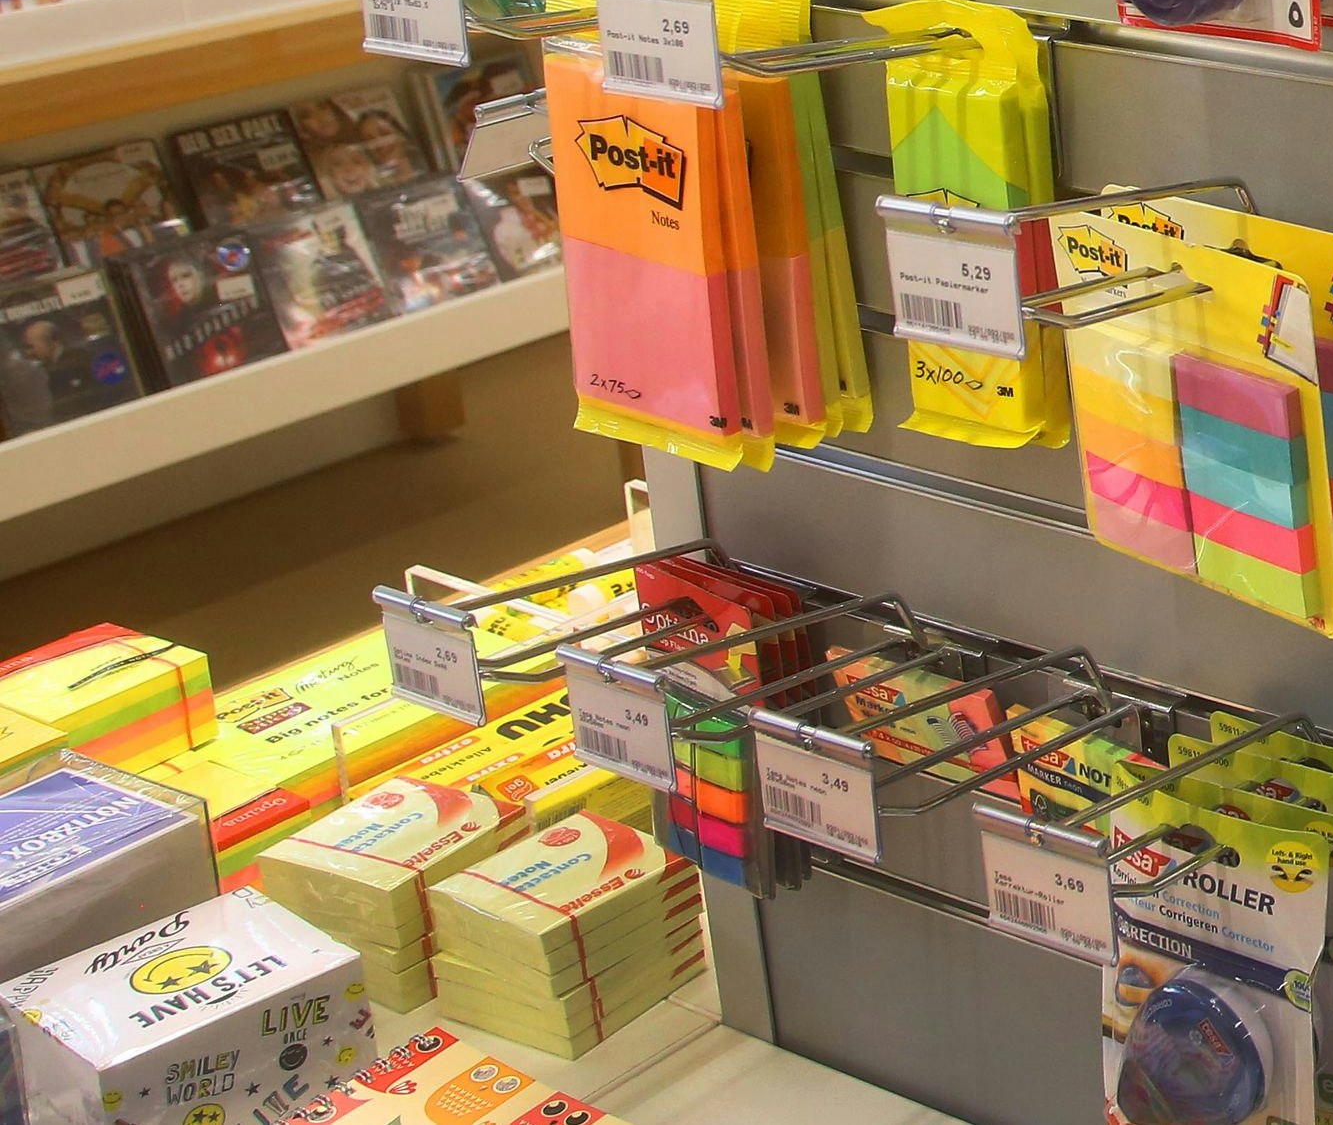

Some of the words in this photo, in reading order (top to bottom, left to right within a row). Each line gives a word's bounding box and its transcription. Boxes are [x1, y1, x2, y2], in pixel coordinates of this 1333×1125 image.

[606, 29, 635, 42] Post-it
[638, 35, 660, 45] Notes
[662, 18, 690, 35] 2,69
[588, 132, 679, 179] Post-it
[650, 209, 681, 232] Notes
[1067, 235, 1124, 270] Post-it
[900, 271, 932, 285] Post-it
[961, 263, 991, 282] 5,29
[590, 373, 627, 396] 2x75
[915, 360, 965, 386] 3x100
[996, 385, 1015, 399] 3M
[709, 415, 728, 429] 3M
[783, 401, 801, 416] 3M
[435, 647, 457, 664] 2,69
[266, 727, 302, 744] Big
[306, 700, 359, 728] notes
[361, 687, 390, 703] for
[624, 709, 649, 726] 3,49
[420, 737, 474, 765] extra
[466, 753, 520, 782] extra
[1027, 762, 1063, 787] MARKER
[822, 772, 849, 793] 3,49
[220, 797, 288, 828] Optima
[1, 796, 145, 863] NOTIZBOX
[401, 830, 465, 870] Esselte
[1271, 848, 1287, 860] Left-
[1295, 850, 1314, 862] Right
[1276, 855, 1292, 866] hand
[1293, 858, 1307, 867] use
[497, 860, 552, 888] Notes
[1055, 873, 1084, 893] 3,69
[559, 876, 626, 914] Esselte
[1162, 890, 1220, 920] Correction
[1182, 870, 1277, 917] ROLLER
[84, 909, 192, 975] Party
[1159, 904, 1219, 935] Corrigeren
[1221, 926, 1276, 954] Corrector
[212, 955, 288, 994] LET'S
[128, 991, 212, 1029] HAVE
[261, 993, 331, 1038] LIVE
[1201, 1022, 1224, 1051] tesa
[164, 1048, 242, 1085] SMILEY
[166, 1071, 236, 1107] WORLD
